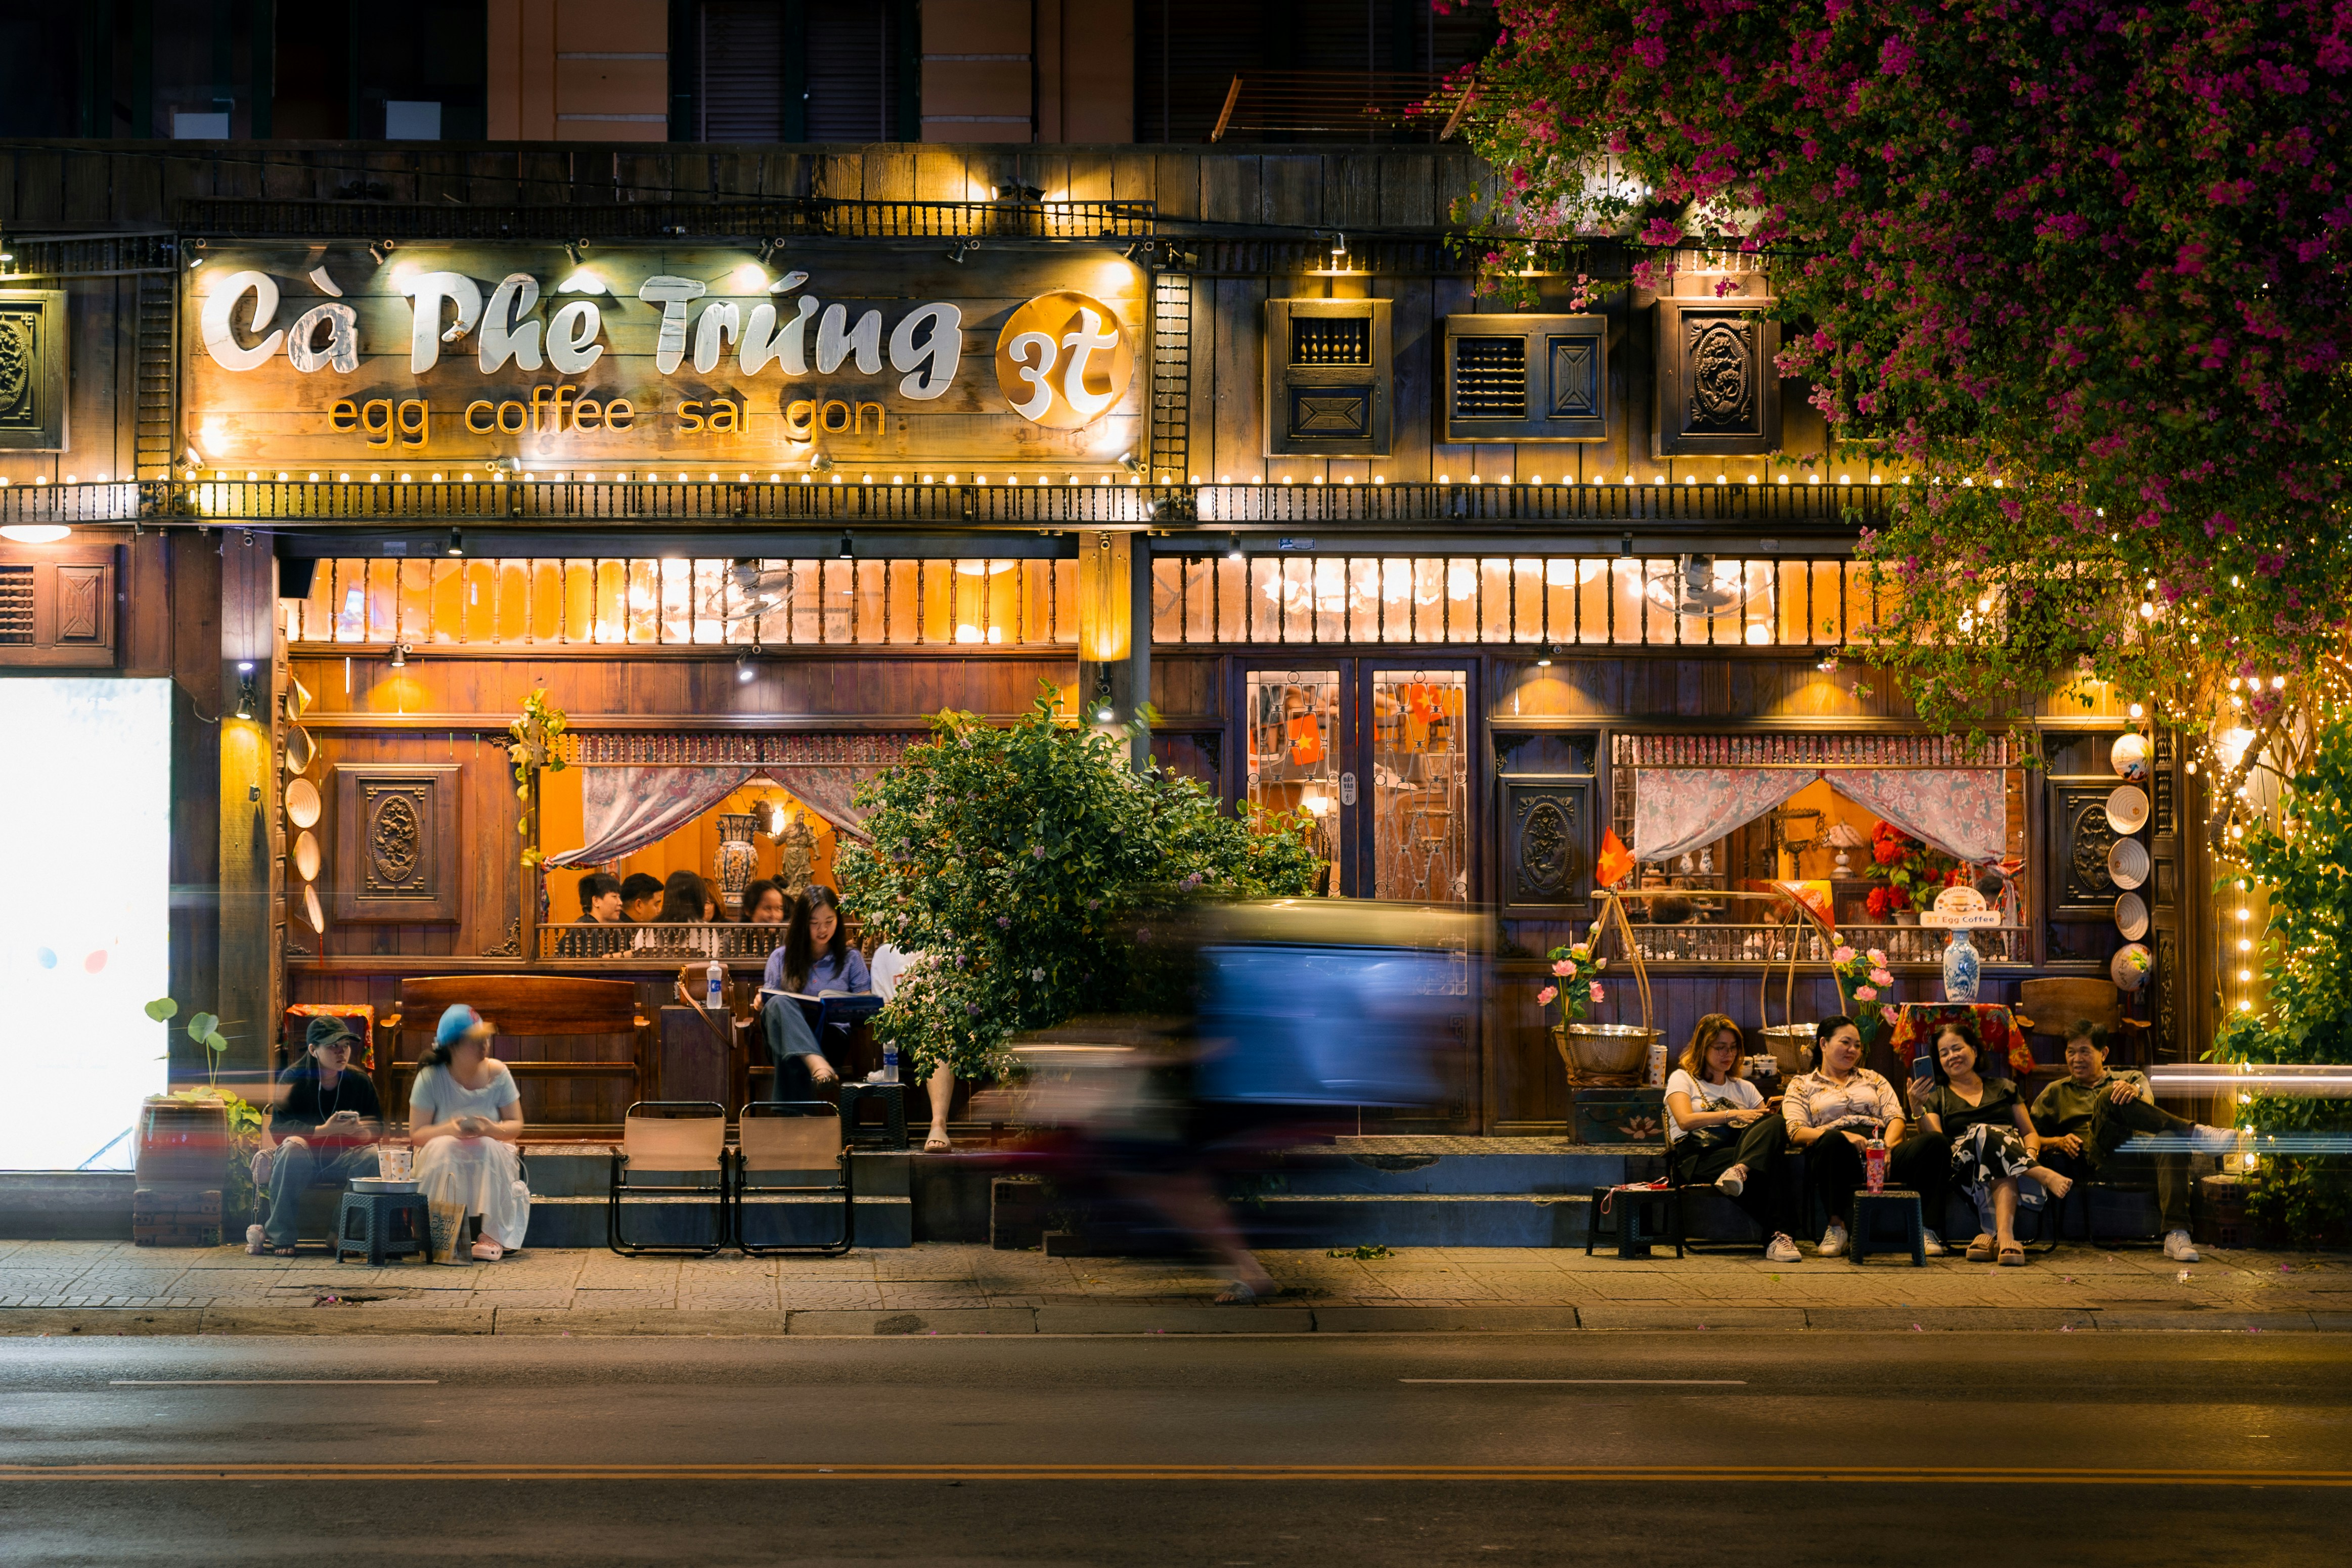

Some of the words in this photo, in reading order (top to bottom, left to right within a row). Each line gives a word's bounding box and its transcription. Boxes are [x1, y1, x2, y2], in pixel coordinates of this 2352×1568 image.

[200, 265, 360, 374] Cà
[401, 270, 607, 375] Phê
[638, 271, 962, 401] Trứng
[328, 398, 429, 450] egg
[465, 384, 635, 434] coffee
[786, 399, 885, 449] gon
[1943, 888, 1968, 896] WELCOME
[430, 1214, 457, 1232] Bath
